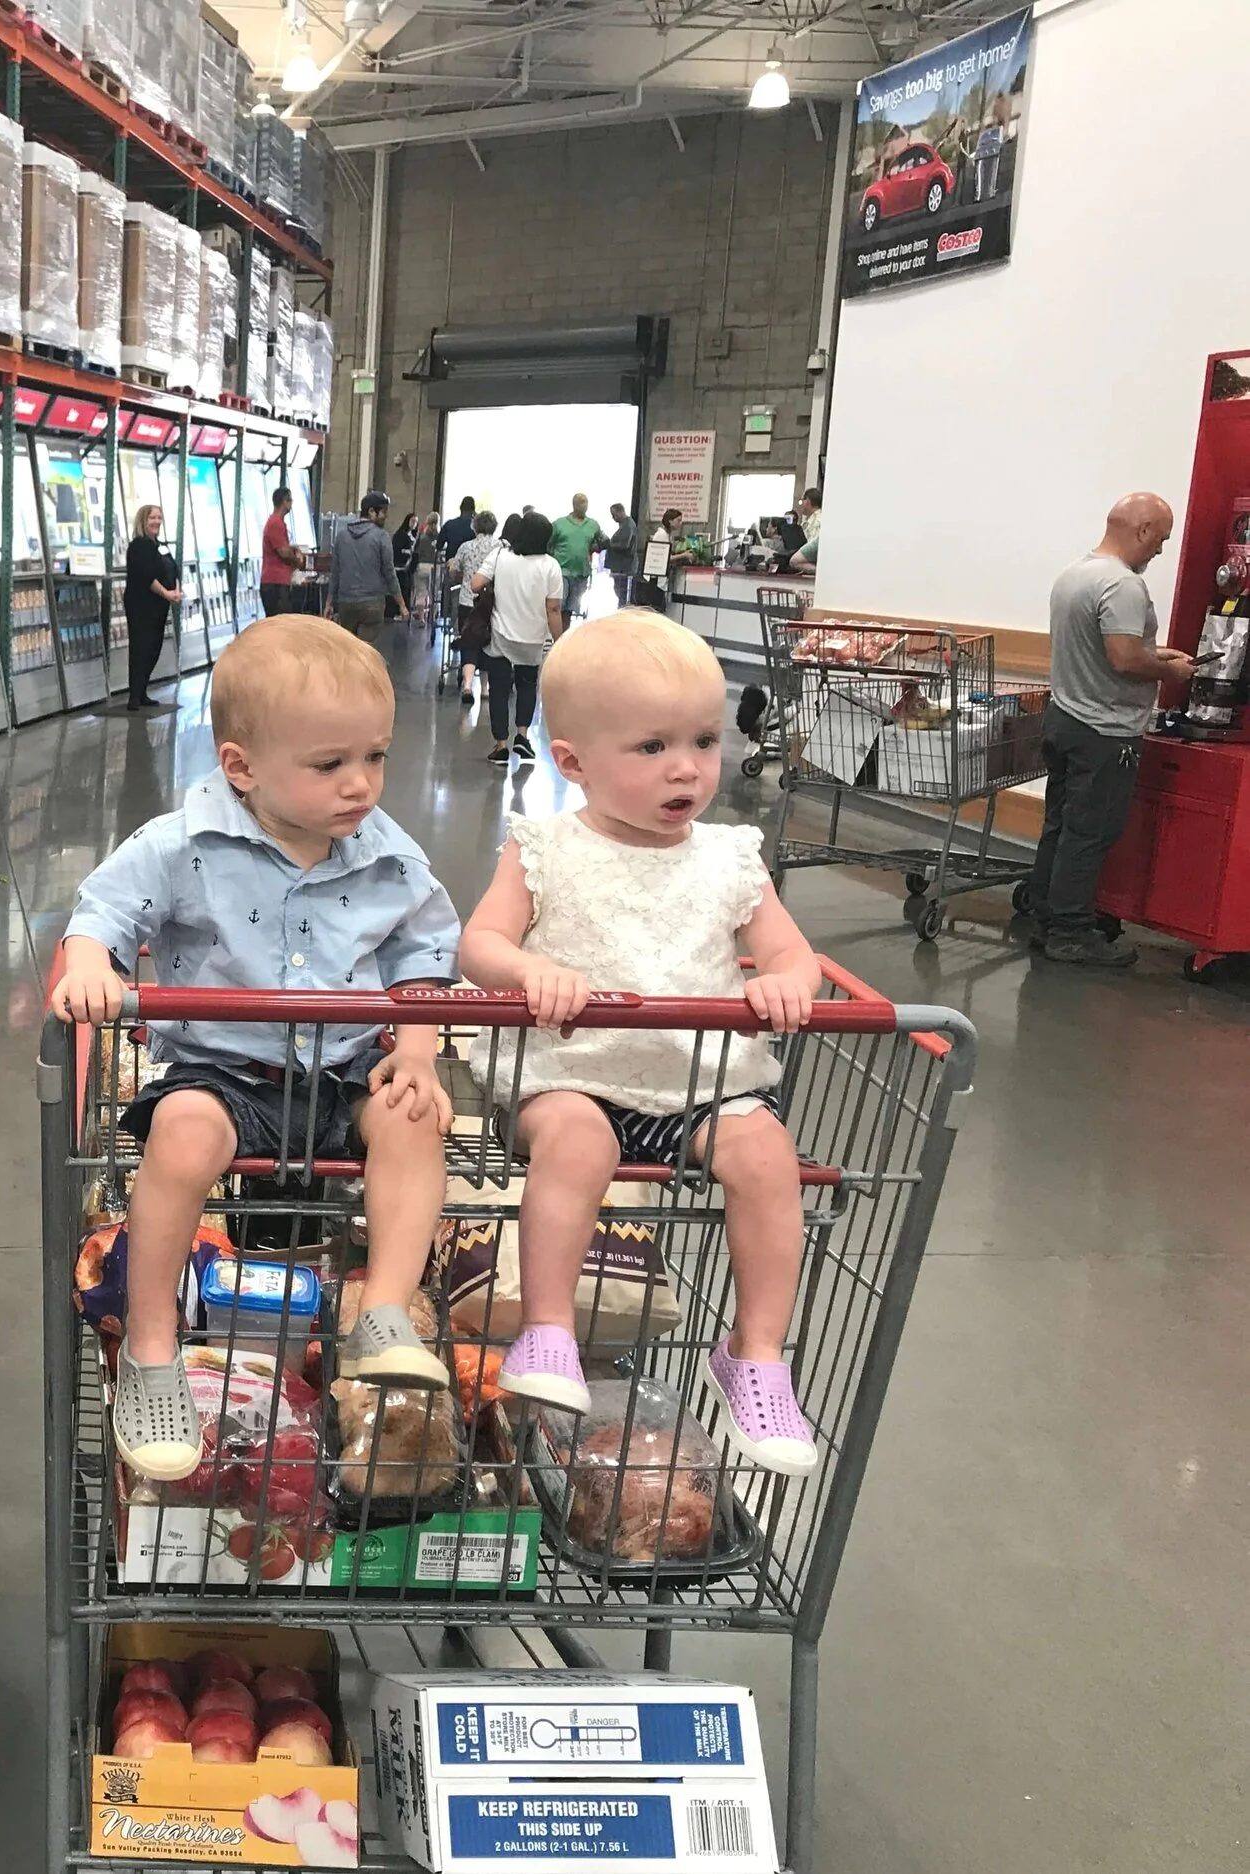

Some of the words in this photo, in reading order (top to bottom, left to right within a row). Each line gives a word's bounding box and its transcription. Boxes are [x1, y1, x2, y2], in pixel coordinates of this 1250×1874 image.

[869, 87, 903, 114] Savings
[905, 79, 924, 100] too
[925, 68, 944, 92] big
[945, 64, 957, 83] to
[959, 54, 976, 83] get
[978, 37, 1017, 70] home?
[938, 228, 981, 253] COSTCO
[887, 244, 900, 258] and
[654, 435, 712, 445] QUESTION:
[656, 472, 704, 481] ANSWER:
[402, 989, 487, 999] COSTCO
[265, 1270, 281, 1292] FETA
[421, 1549, 446, 1557] GRAPE
[466, 1550, 475, 1558] LB
[477, 1551, 501, 1559] CLAM)
[509, 1573, 518, 1581] 20
[587, 1717, 621, 1726] DANGER
[693, 1709, 699, 1720] OF
[467, 1706, 480, 1745] KEEP
[490, 1720, 496, 1729] TO
[496, 1720, 502, 1730] AT
[454, 1715, 467, 1754] COLD
[508, 1711, 517, 1754] PROTECTION
[708, 1713, 717, 1755] PROTECTS
[714, 1715, 723, 1753] CONTROL
[720, 1706, 731, 1761] TEMPERATURE
[703, 1726, 712, 1758] QUALITY
[470, 1748, 481, 1762] IT
[388, 1705, 407, 1824] MILK
[100, 1767, 142, 1784] TRINITY
[417, 1731, 429, 1831] KIRKLAND
[478, 1802, 517, 1817] KEEP
[523, 1802, 639, 1818] REFRIGERATED
[717, 1799, 738, 1807] ART.
[165, 1813, 191, 1822] White
[193, 1814, 217, 1824] Flesh
[99, 1807, 246, 1846] Nectarines
[517, 1823, 548, 1837] THIS
[553, 1823, 580, 1837] SIDE
[584, 1823, 604, 1837] UP
[102, 1843, 115, 1851] Sun
[118, 1844, 141, 1854] Valley
[143, 1846, 172, 1855] Packing
[208, 1847, 218, 1857] CA
[495, 1841, 502, 1852] 2
[504, 1841, 547, 1853] GALLONS
[550, 1841, 570, 1854] (2-1
[573, 1842, 598, 1855] GAL.)
[600, 1842, 622, 1854] 7.56
[624, 1842, 631, 1854] L
